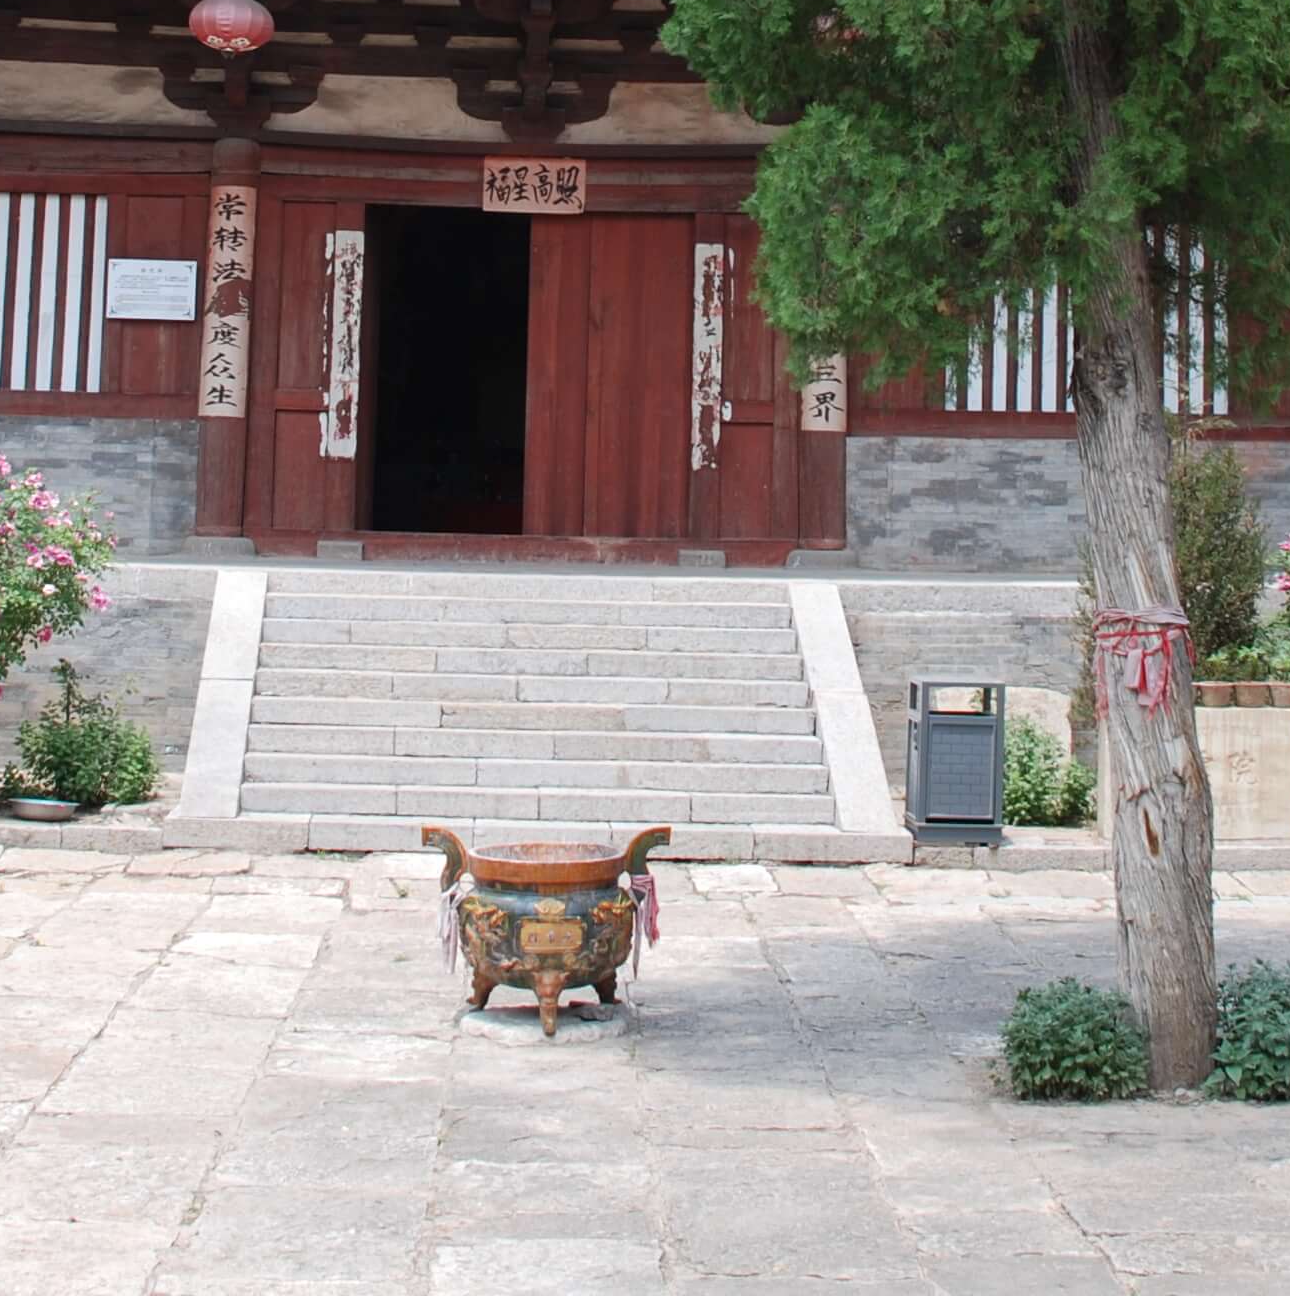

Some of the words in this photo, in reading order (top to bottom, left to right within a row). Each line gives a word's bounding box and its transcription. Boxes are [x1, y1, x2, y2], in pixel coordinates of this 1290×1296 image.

[485, 164, 583, 209] 福星高照
[204, 192, 249, 408] 常转法度众生
